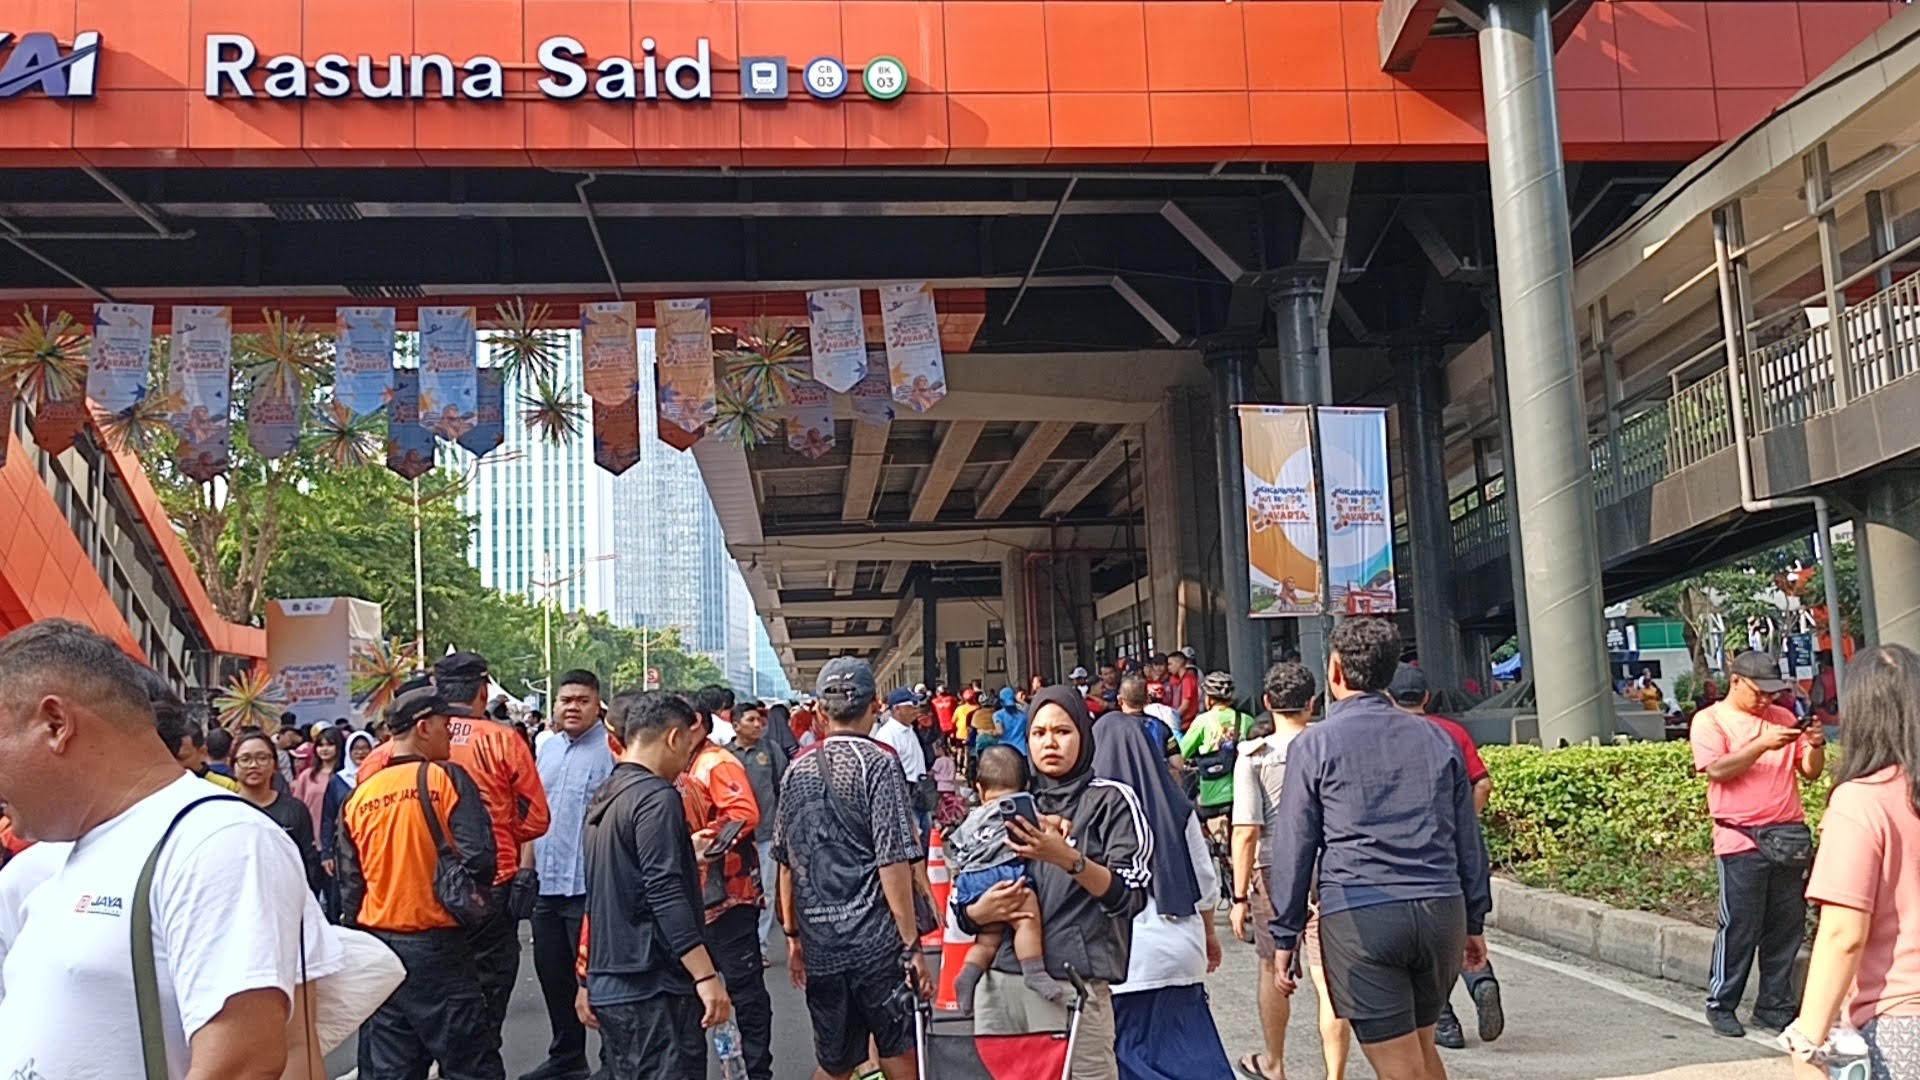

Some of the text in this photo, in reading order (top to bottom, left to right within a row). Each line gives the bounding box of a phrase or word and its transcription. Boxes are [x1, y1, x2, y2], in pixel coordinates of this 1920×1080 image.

[0, 30, 100, 97] AI
[205, 33, 713, 100] Rasuna Said
[818, 65, 832, 74] CB
[878, 66, 891, 75] BK
[816, 76, 834, 88] 03
[876, 77, 894, 89] 03
[399, 788, 441, 802] JAKTA
[91, 896, 122, 910] JAYA
